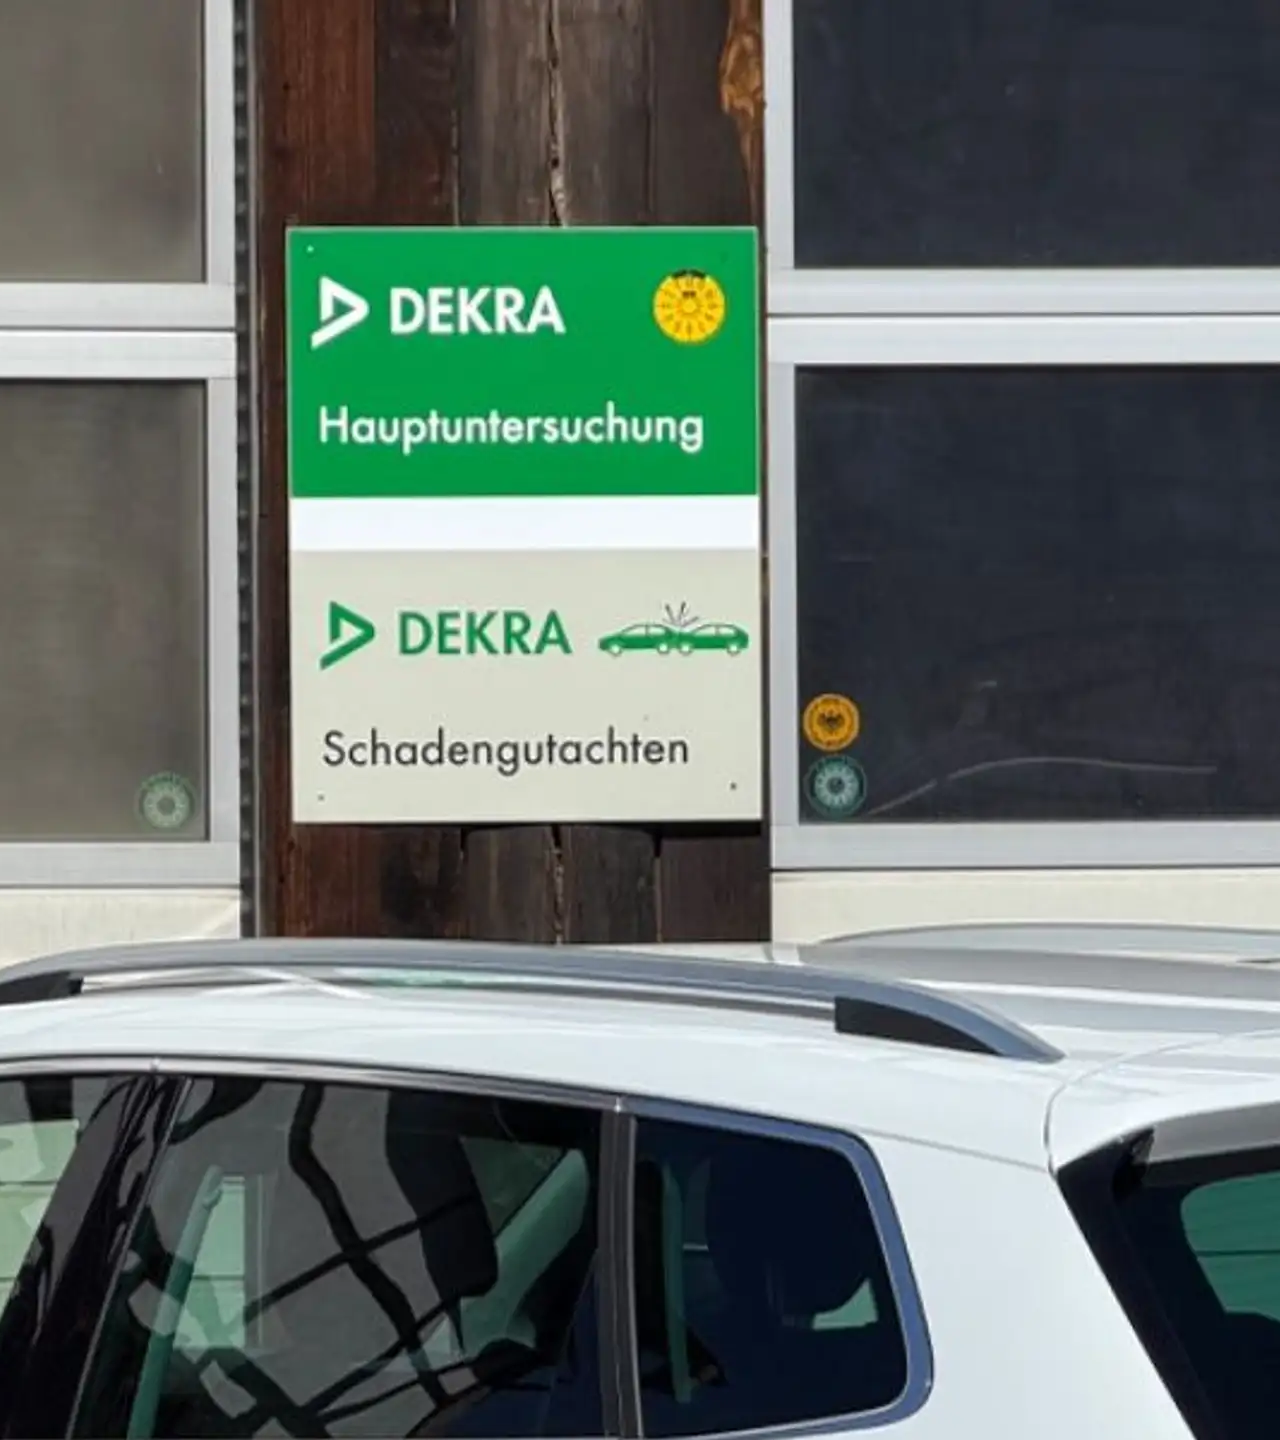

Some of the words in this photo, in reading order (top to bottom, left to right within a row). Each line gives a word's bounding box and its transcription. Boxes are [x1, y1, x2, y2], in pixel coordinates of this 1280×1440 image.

[389, 286, 566, 336] DEKRA
[319, 401, 705, 454] Hauptuntersuchung
[398, 611, 572, 656] DEKRA
[322, 726, 690, 776] Schadengutachten
